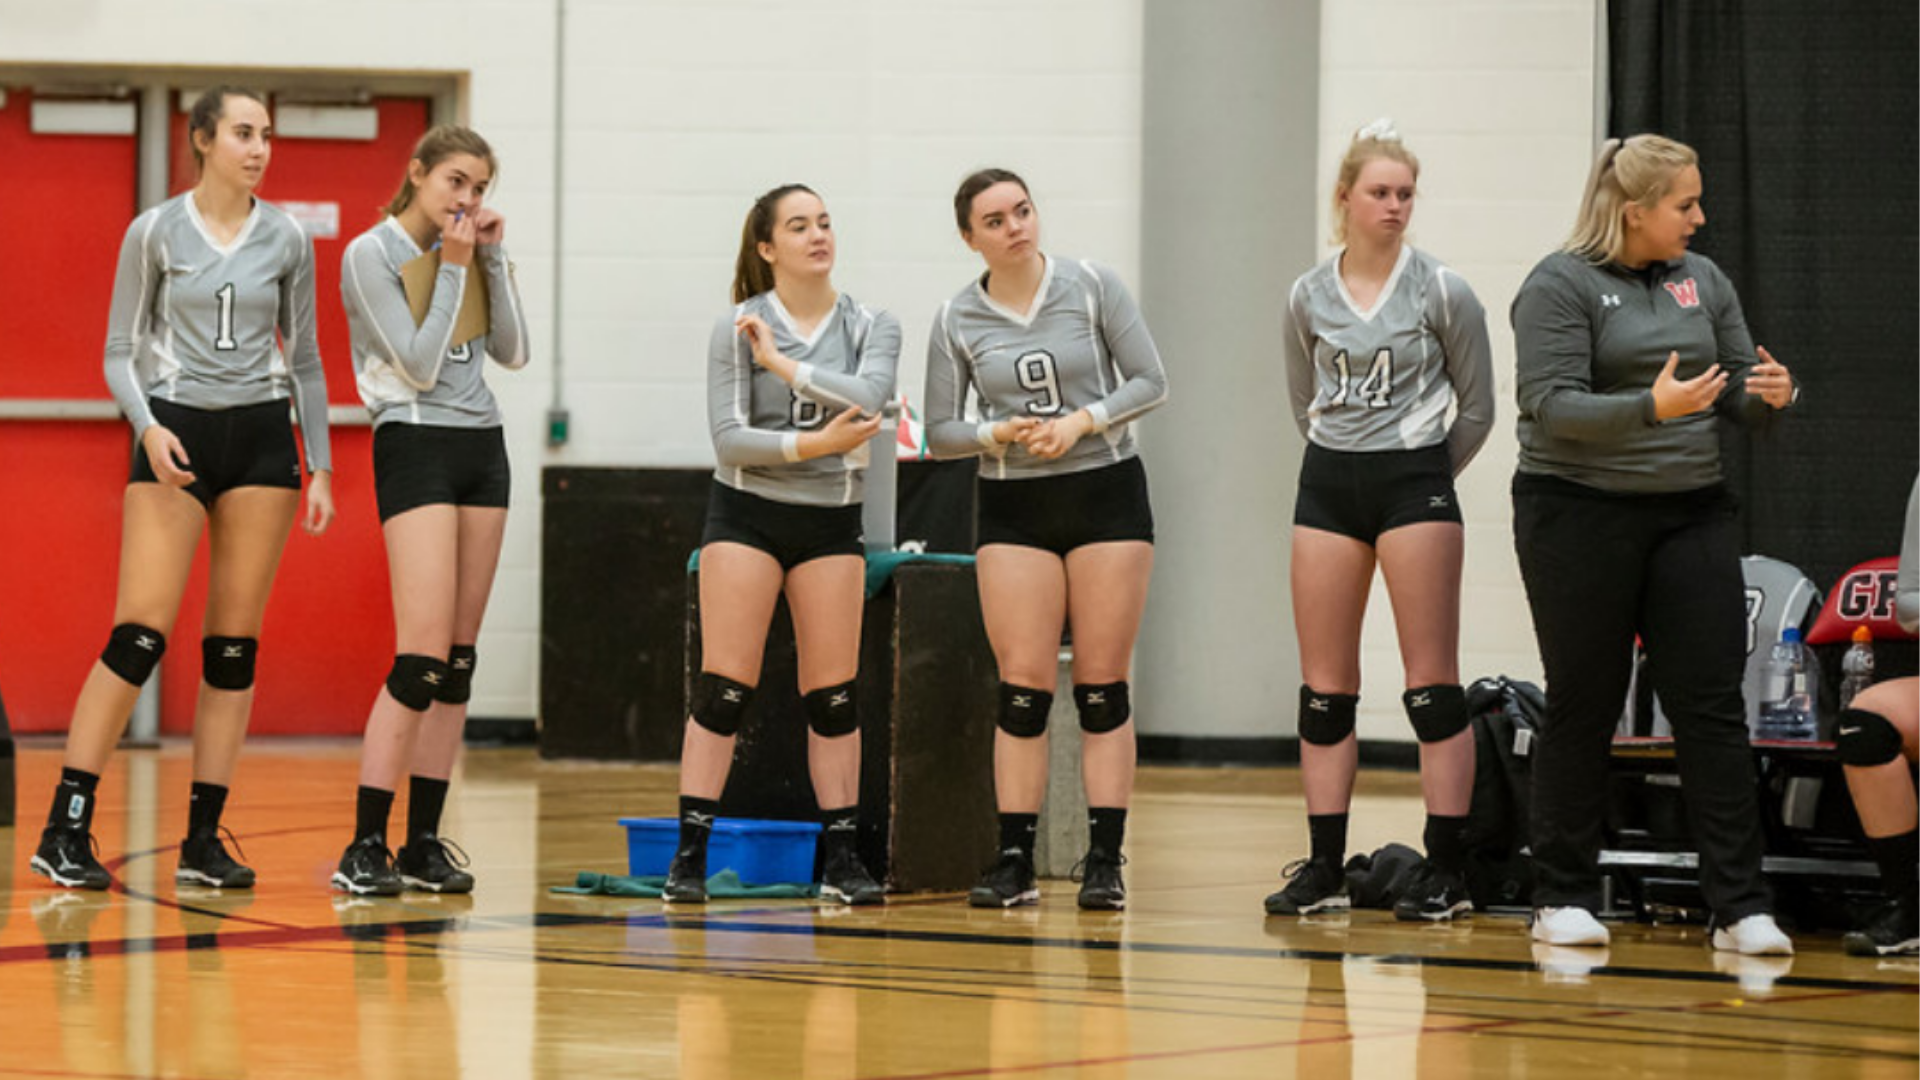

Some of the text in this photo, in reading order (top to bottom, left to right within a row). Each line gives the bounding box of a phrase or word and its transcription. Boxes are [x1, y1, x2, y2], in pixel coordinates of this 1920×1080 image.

[214, 282, 238, 351] 1
[1664, 278, 1700, 308] W
[1014, 349, 1063, 416] 9
[1330, 347, 1395, 409] 14
